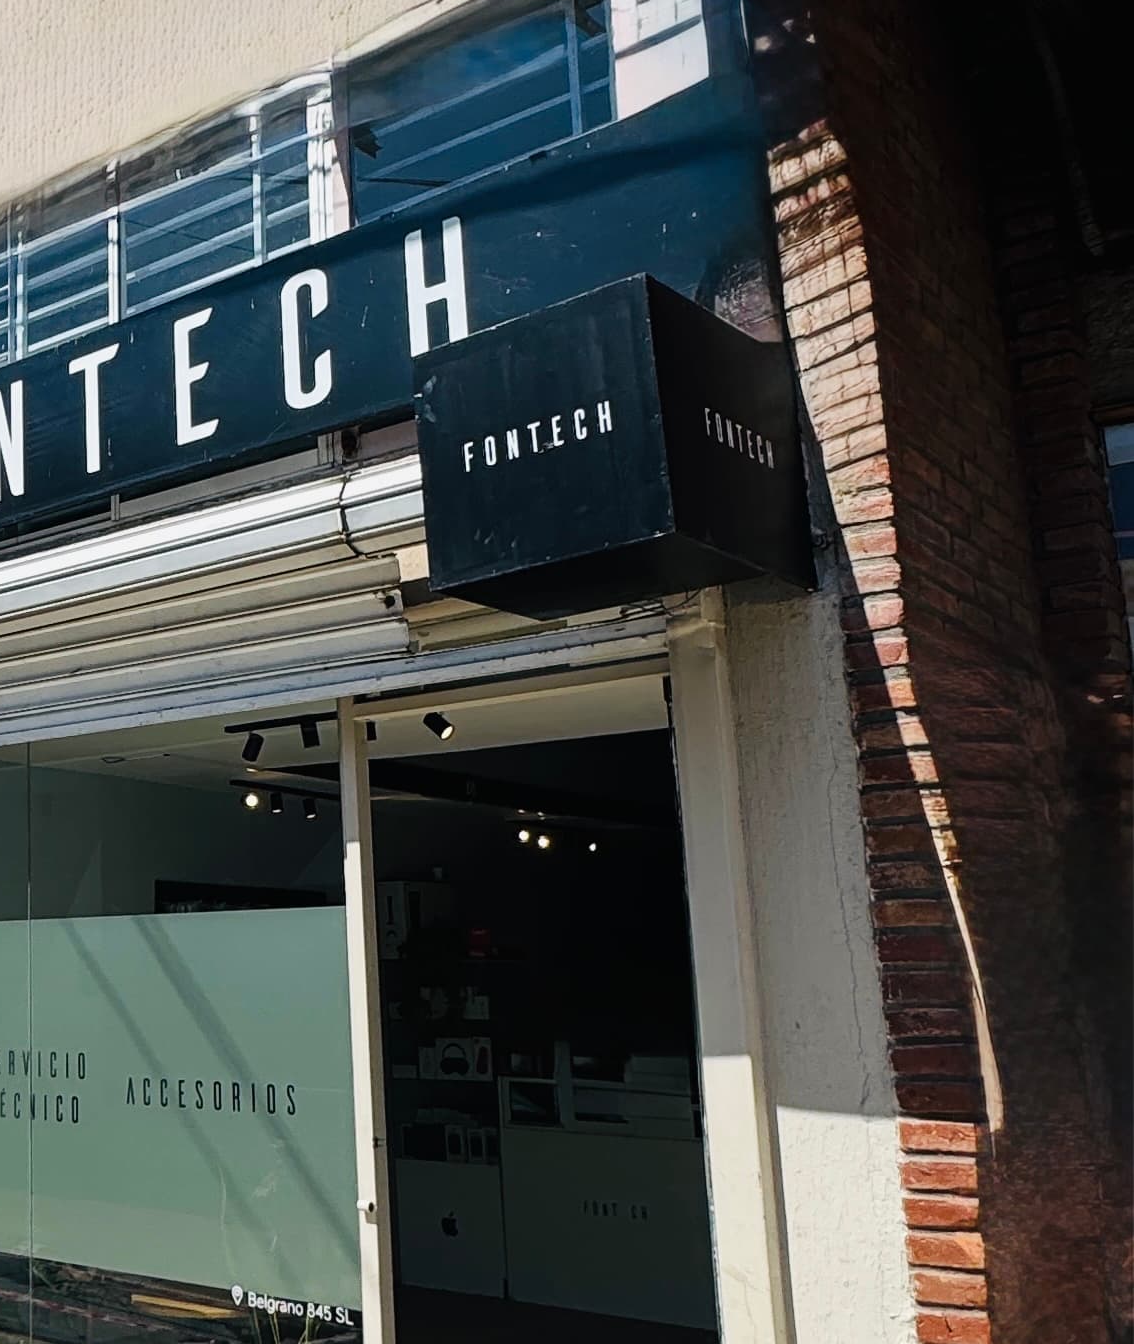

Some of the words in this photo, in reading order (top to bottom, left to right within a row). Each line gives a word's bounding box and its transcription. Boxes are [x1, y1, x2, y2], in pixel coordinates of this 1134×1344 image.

[463, 400, 613, 473] FONTECH
[704, 407, 775, 469] FONTECH
[126, 1076, 297, 1116] ACCESORIOS
[247, 1291, 304, 1316] Belgrano
[306, 1302, 332, 1322] 845
[335, 1306, 355, 1326] SL
